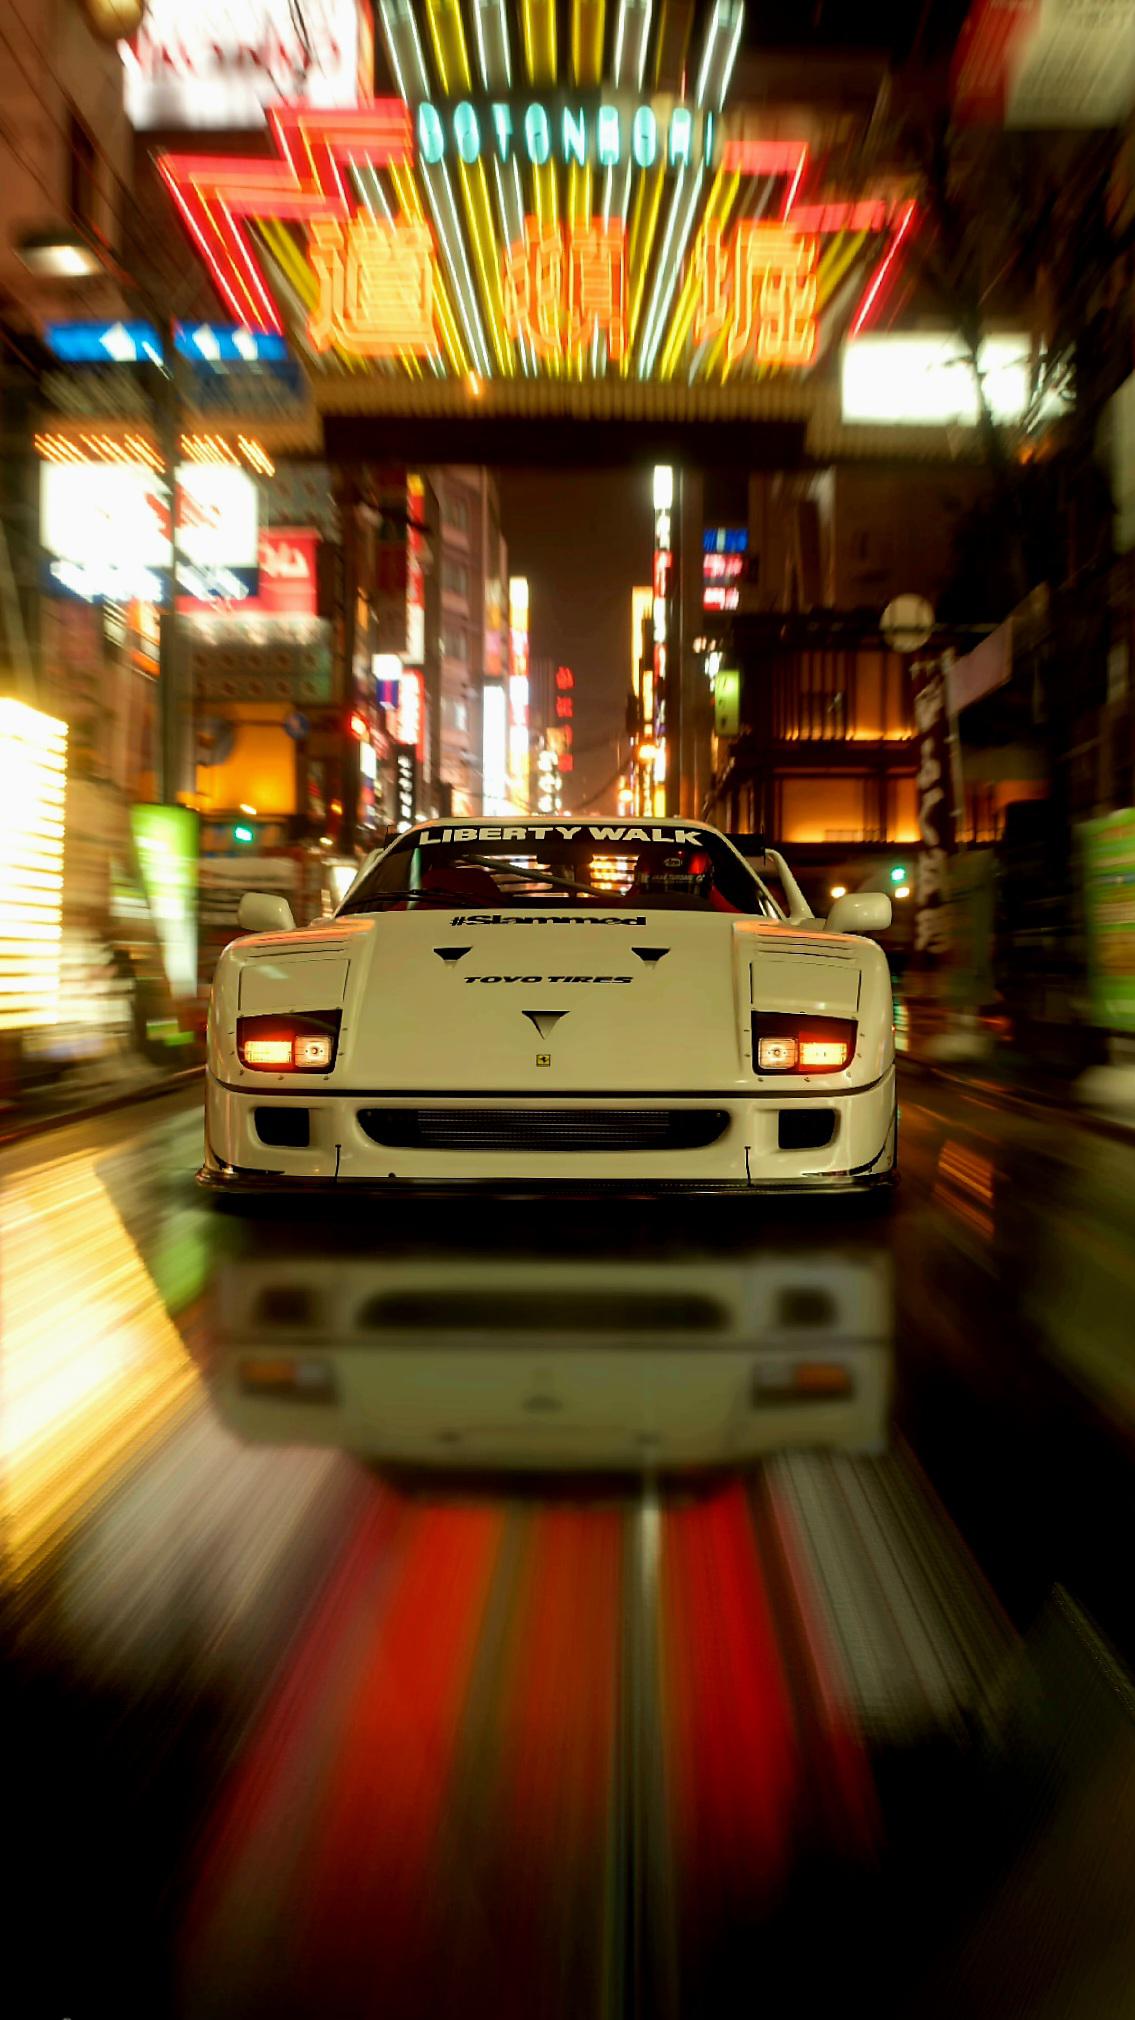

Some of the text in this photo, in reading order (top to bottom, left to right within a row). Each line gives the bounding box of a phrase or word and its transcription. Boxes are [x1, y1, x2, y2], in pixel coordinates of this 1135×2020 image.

[419, 826, 704, 847] LIBERTY WALK
[449, 914, 647, 927] #Slammed
[464, 976, 634, 984] TOYO TIRES
